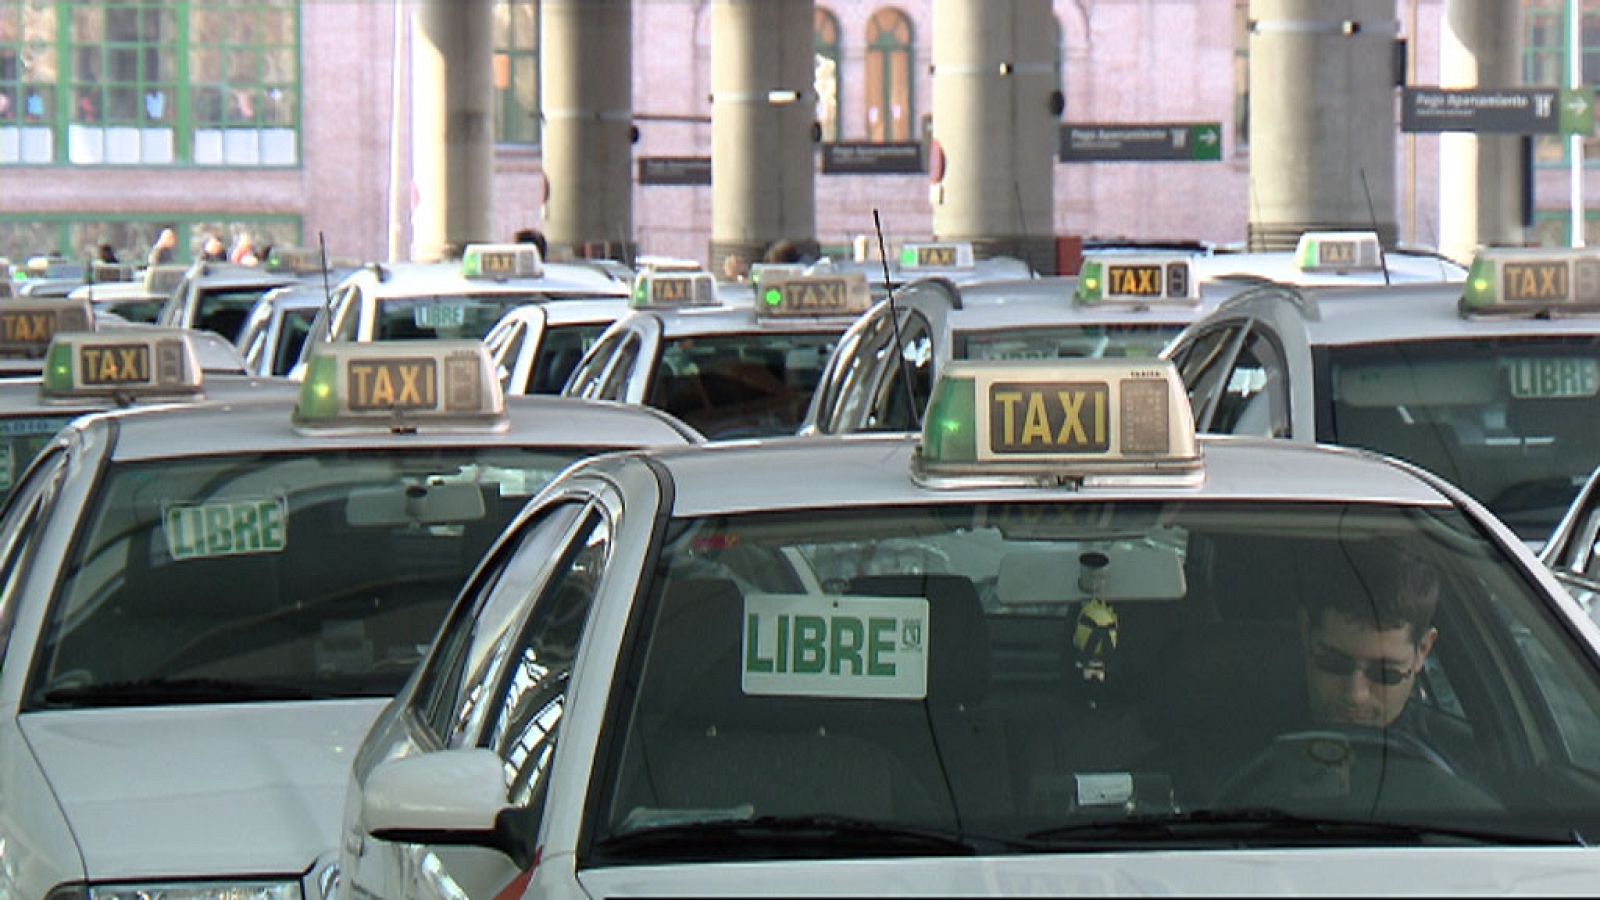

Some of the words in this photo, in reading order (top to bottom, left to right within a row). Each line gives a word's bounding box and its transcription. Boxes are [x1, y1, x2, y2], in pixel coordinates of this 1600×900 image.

[653, 279, 691, 301] TAXI
[788, 283, 845, 308] TAXI
[1112, 268, 1159, 293] TAXI
[1508, 267, 1567, 298] TAXI
[2, 313, 56, 341] TAXI
[83, 348, 149, 381] TAXI
[1514, 360, 1595, 396] LIBRE
[352, 365, 434, 405] TAXI
[994, 390, 1106, 446] TAXI
[170, 500, 284, 557] LIBRE
[746, 612, 896, 676] LIBRE
